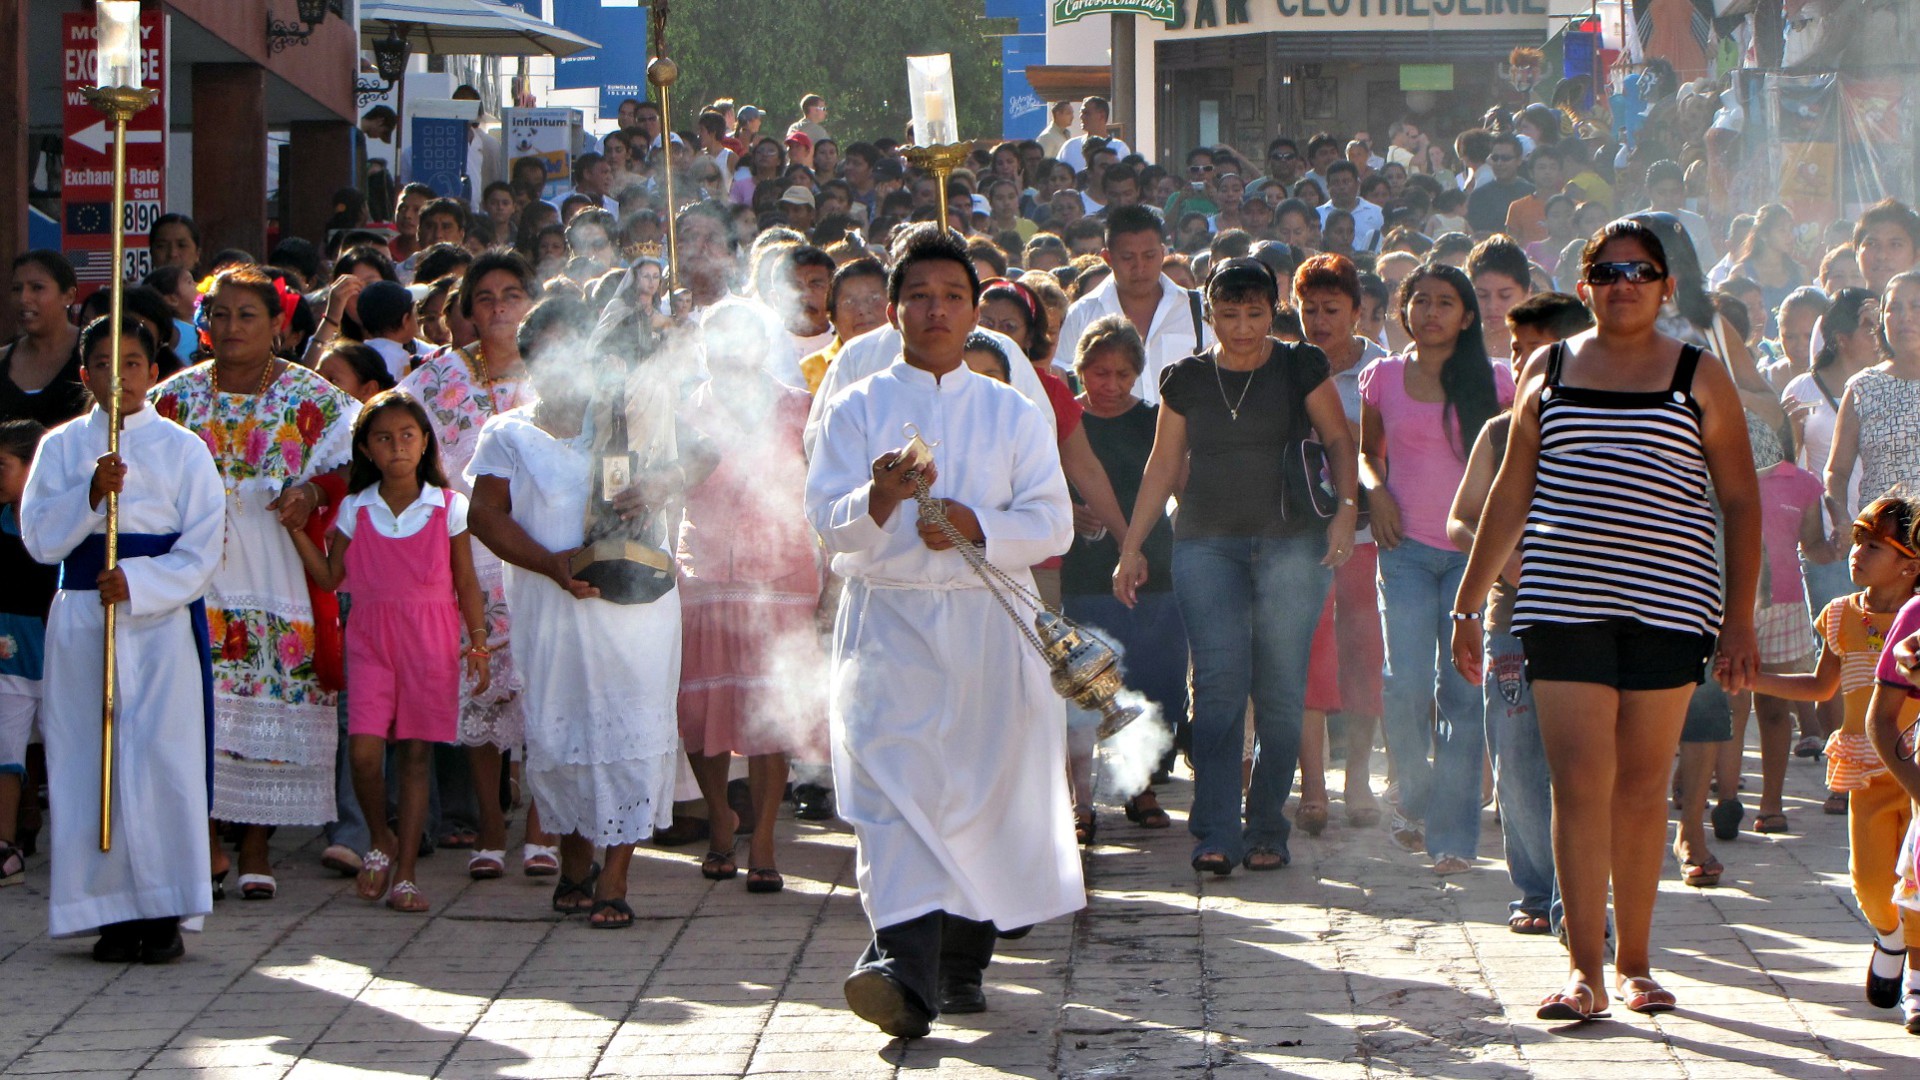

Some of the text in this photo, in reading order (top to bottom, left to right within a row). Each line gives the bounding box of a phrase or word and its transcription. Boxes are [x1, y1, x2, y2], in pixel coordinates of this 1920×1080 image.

[65, 48, 160, 80] EXCGE
[512, 117, 567, 127] infinitum
[64, 168, 160, 186] Exchang Rate
[134, 188, 159, 199] Sell
